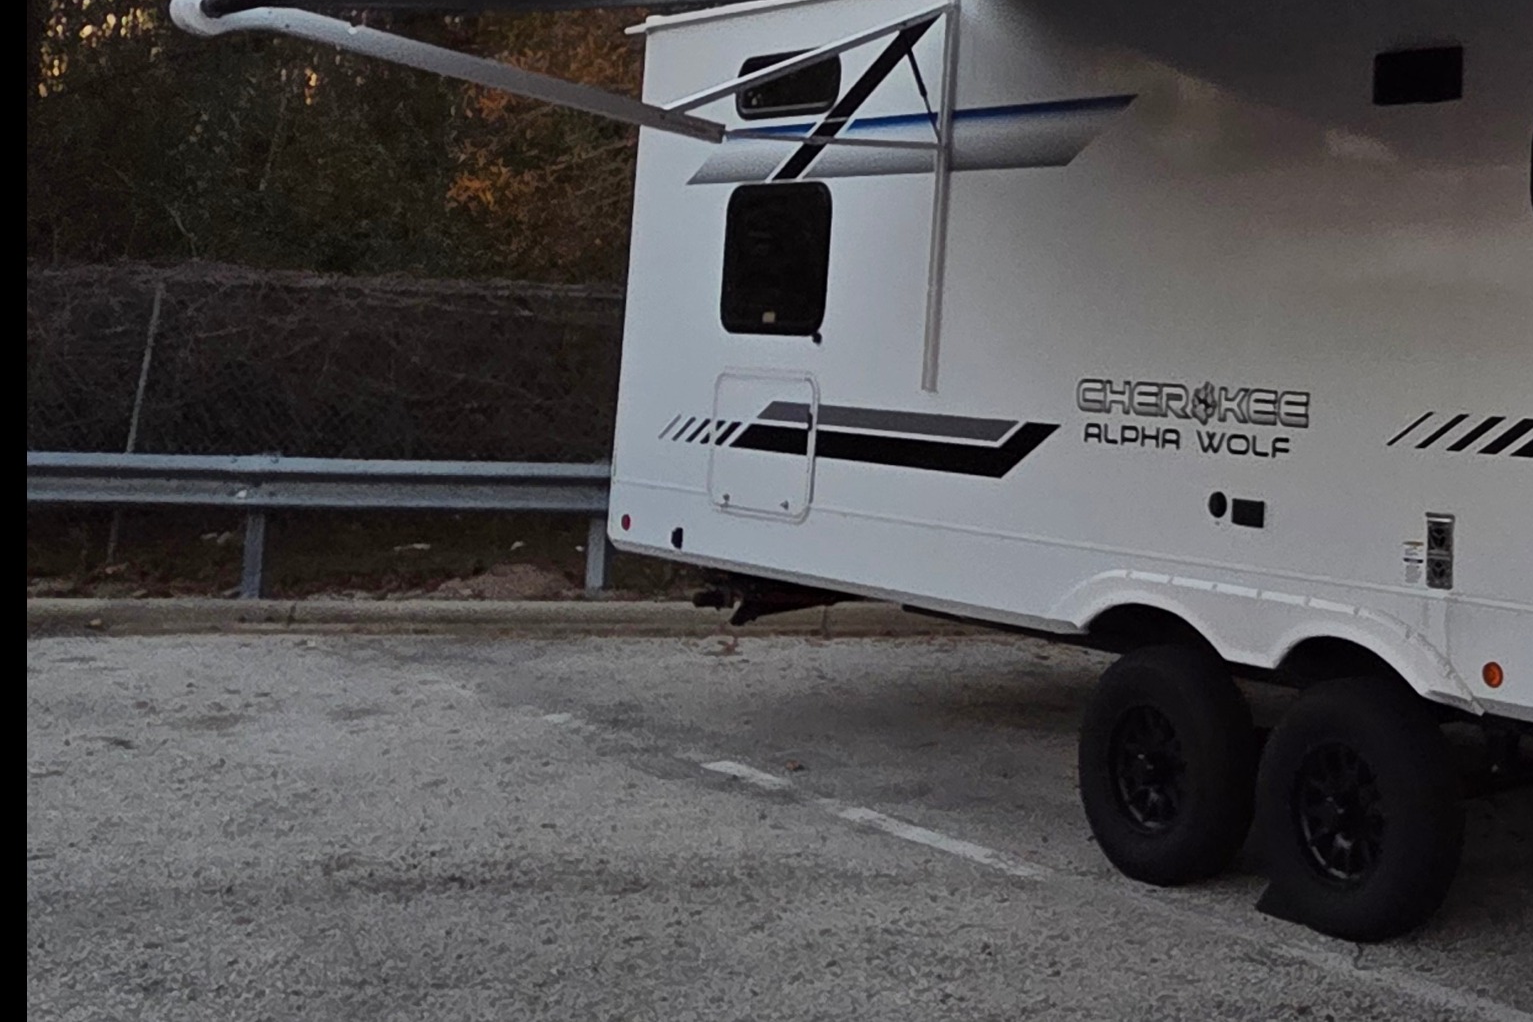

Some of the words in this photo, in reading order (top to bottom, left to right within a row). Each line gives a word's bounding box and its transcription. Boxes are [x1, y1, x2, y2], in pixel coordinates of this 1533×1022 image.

[1076, 378, 1311, 429] CHEROKEE
[1083, 422, 1181, 450] ALPHA
[1196, 429, 1291, 458] WOLF
